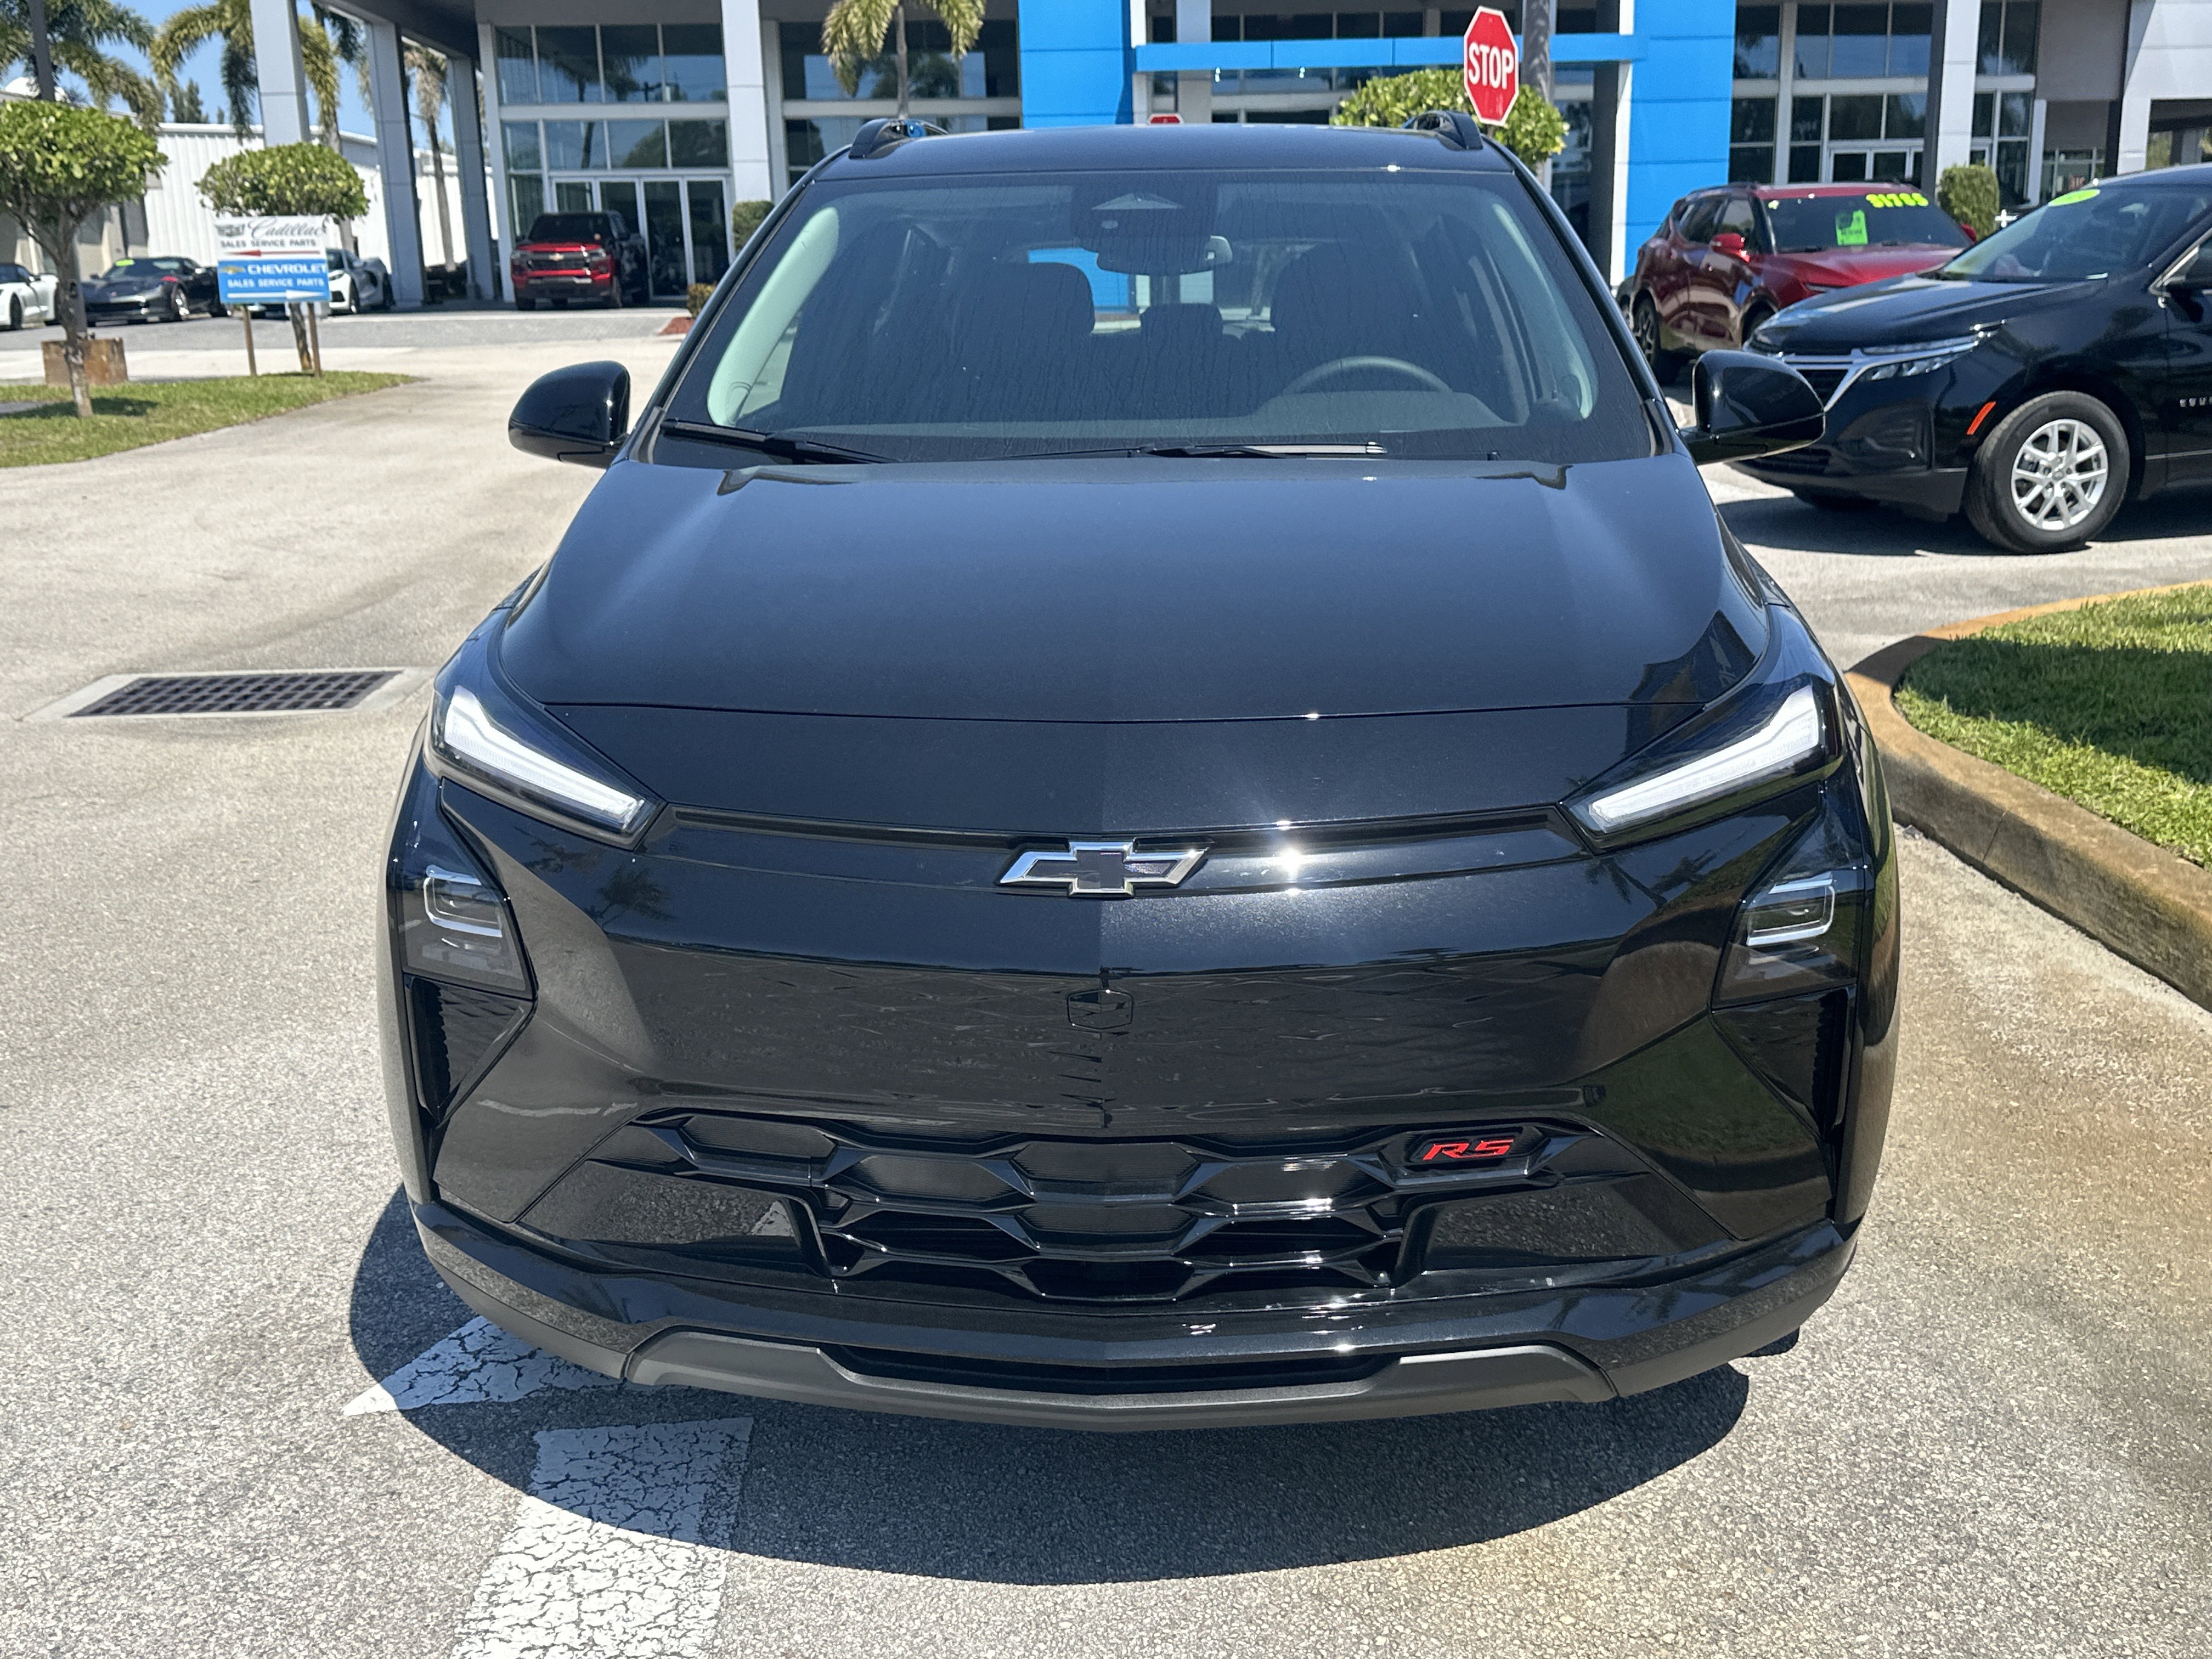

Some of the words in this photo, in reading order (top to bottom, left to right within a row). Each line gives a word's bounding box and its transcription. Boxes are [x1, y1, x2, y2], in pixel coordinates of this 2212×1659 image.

[1468, 42, 1514, 90] STOP
[247, 217, 321, 239] Cadillac
[250, 239, 285, 247] SERVICE
[289, 238, 316, 246] PARTS
[247, 263, 327, 274] CHEVROLET
[227, 279, 255, 288] SALES
[258, 278, 293, 287] SERVICE
[297, 278, 325, 286] PARTS
[1423, 1138, 1514, 1161] RS
